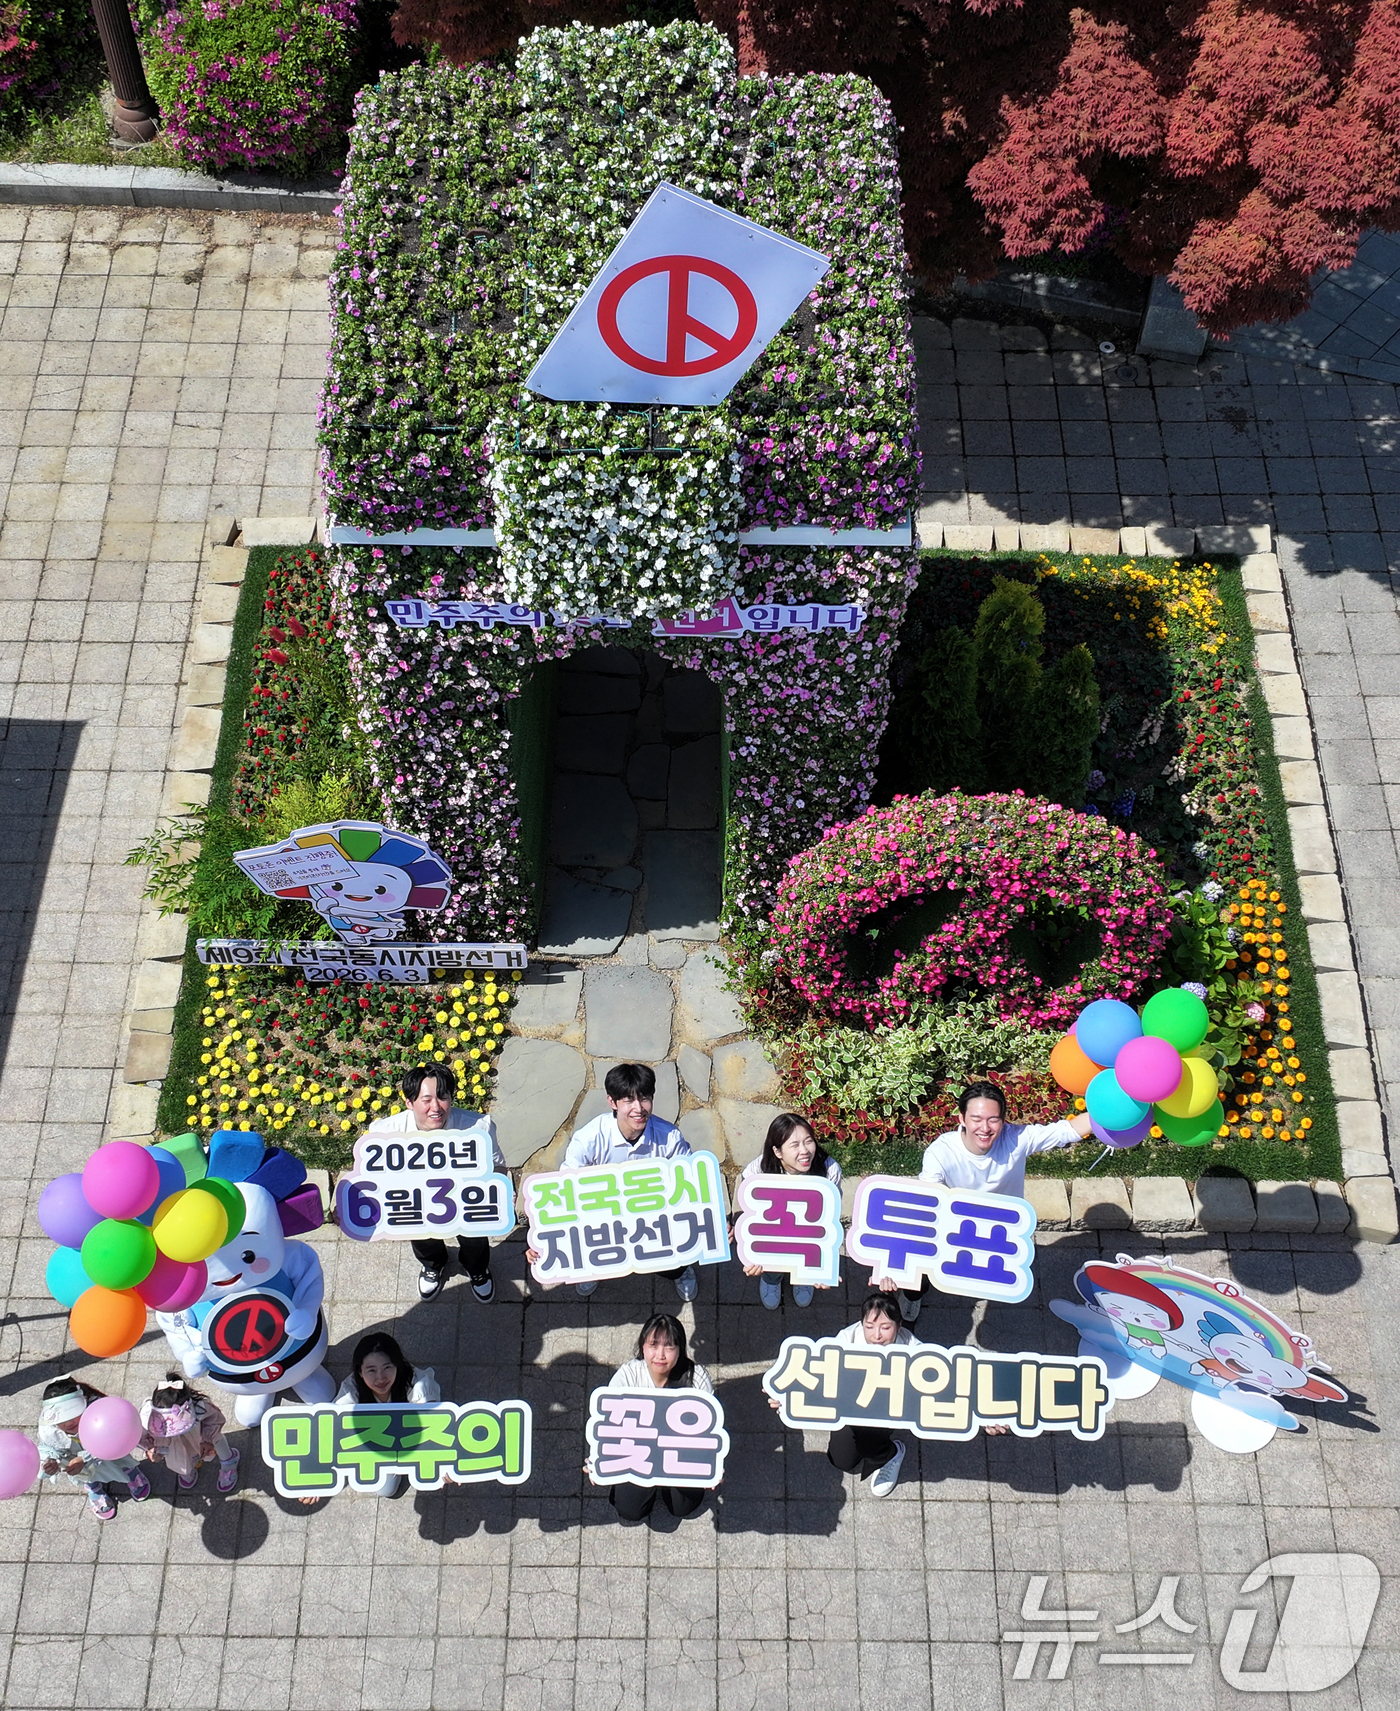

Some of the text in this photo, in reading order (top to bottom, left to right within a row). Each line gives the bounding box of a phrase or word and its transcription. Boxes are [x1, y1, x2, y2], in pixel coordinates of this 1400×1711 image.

[389, 602, 541, 627] 민주주의
[276, 856, 305, 866] 이벤트
[205, 946, 523, 968] 제9회 전국동시지방선거
[366, 1140, 478, 1171] 2026년
[532, 1161, 711, 1226] 전국동시
[537, 1208, 718, 1271] 지방선거
[748, 1187, 825, 1267] 꼭
[860, 1188, 1021, 1284] 투표
[772, 1345, 1107, 1432] 선거입니다
[272, 1410, 520, 1487] 민주주의
[597, 1397, 719, 1476] 꽃은
